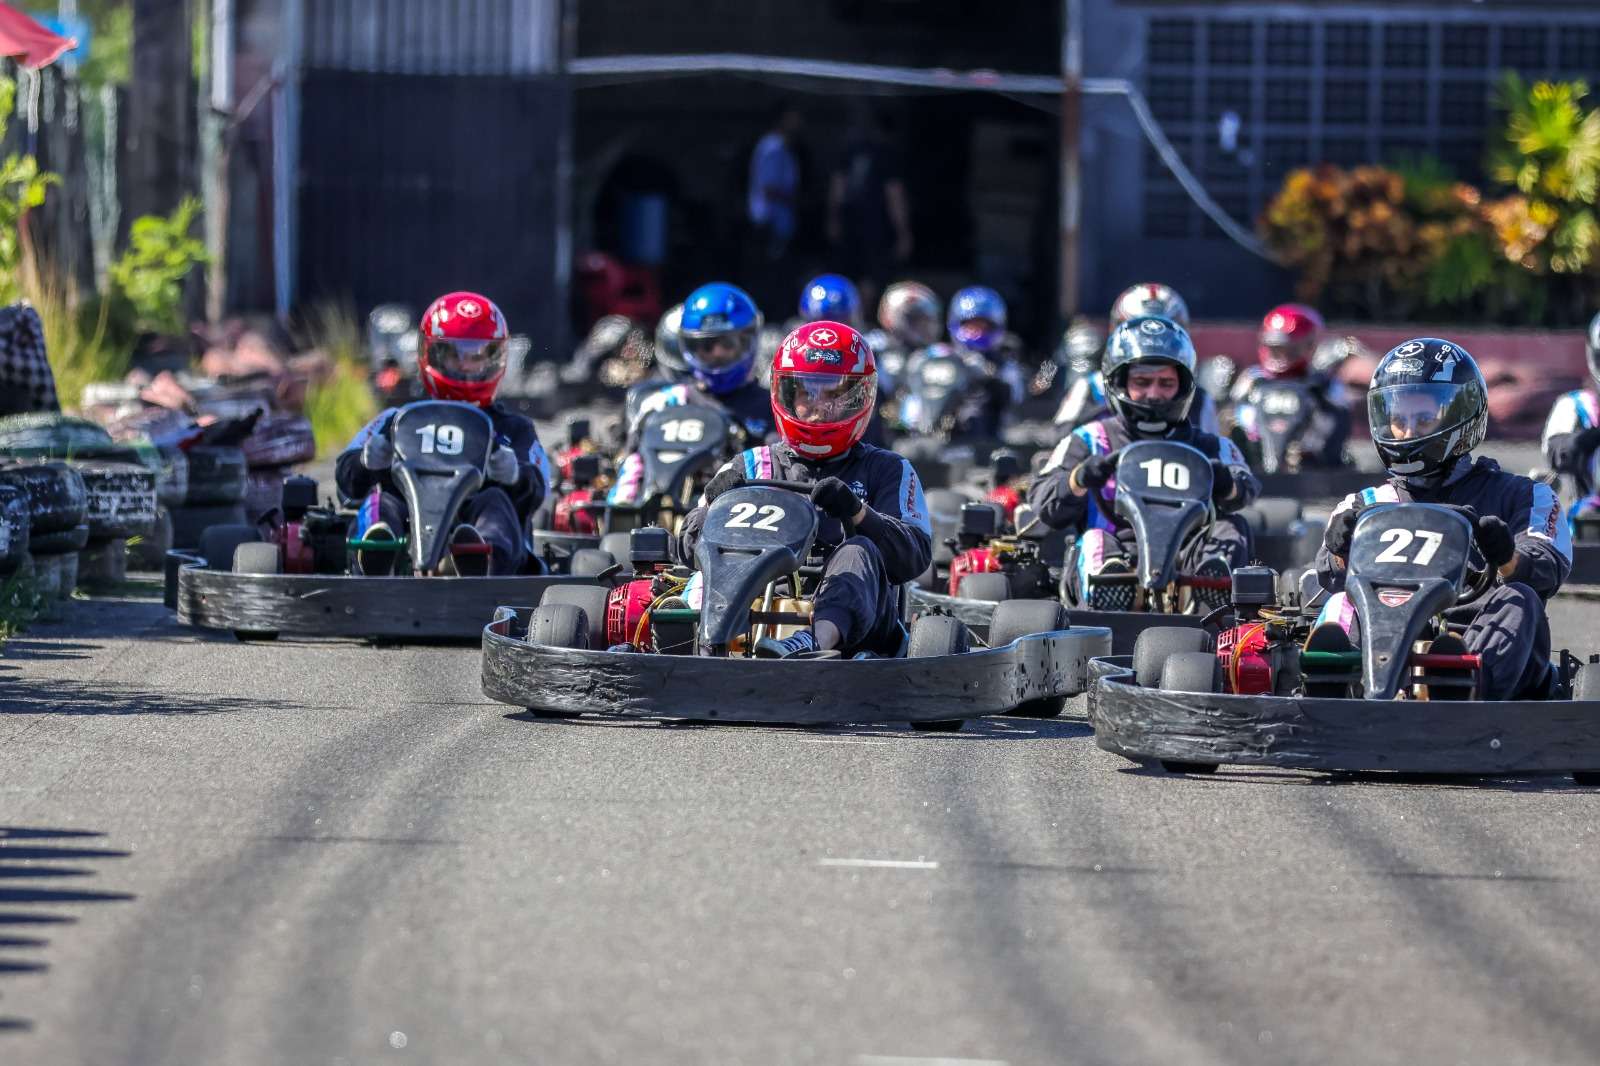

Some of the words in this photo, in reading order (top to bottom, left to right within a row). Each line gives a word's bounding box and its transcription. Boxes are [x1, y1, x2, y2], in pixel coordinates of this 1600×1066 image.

[1434, 344, 1452, 363] F-8
[416, 424, 464, 455] 19
[661, 419, 704, 442] 16
[1140, 458, 1190, 490] 10
[724, 502, 786, 532] 22
[1374, 528, 1444, 566] 27
